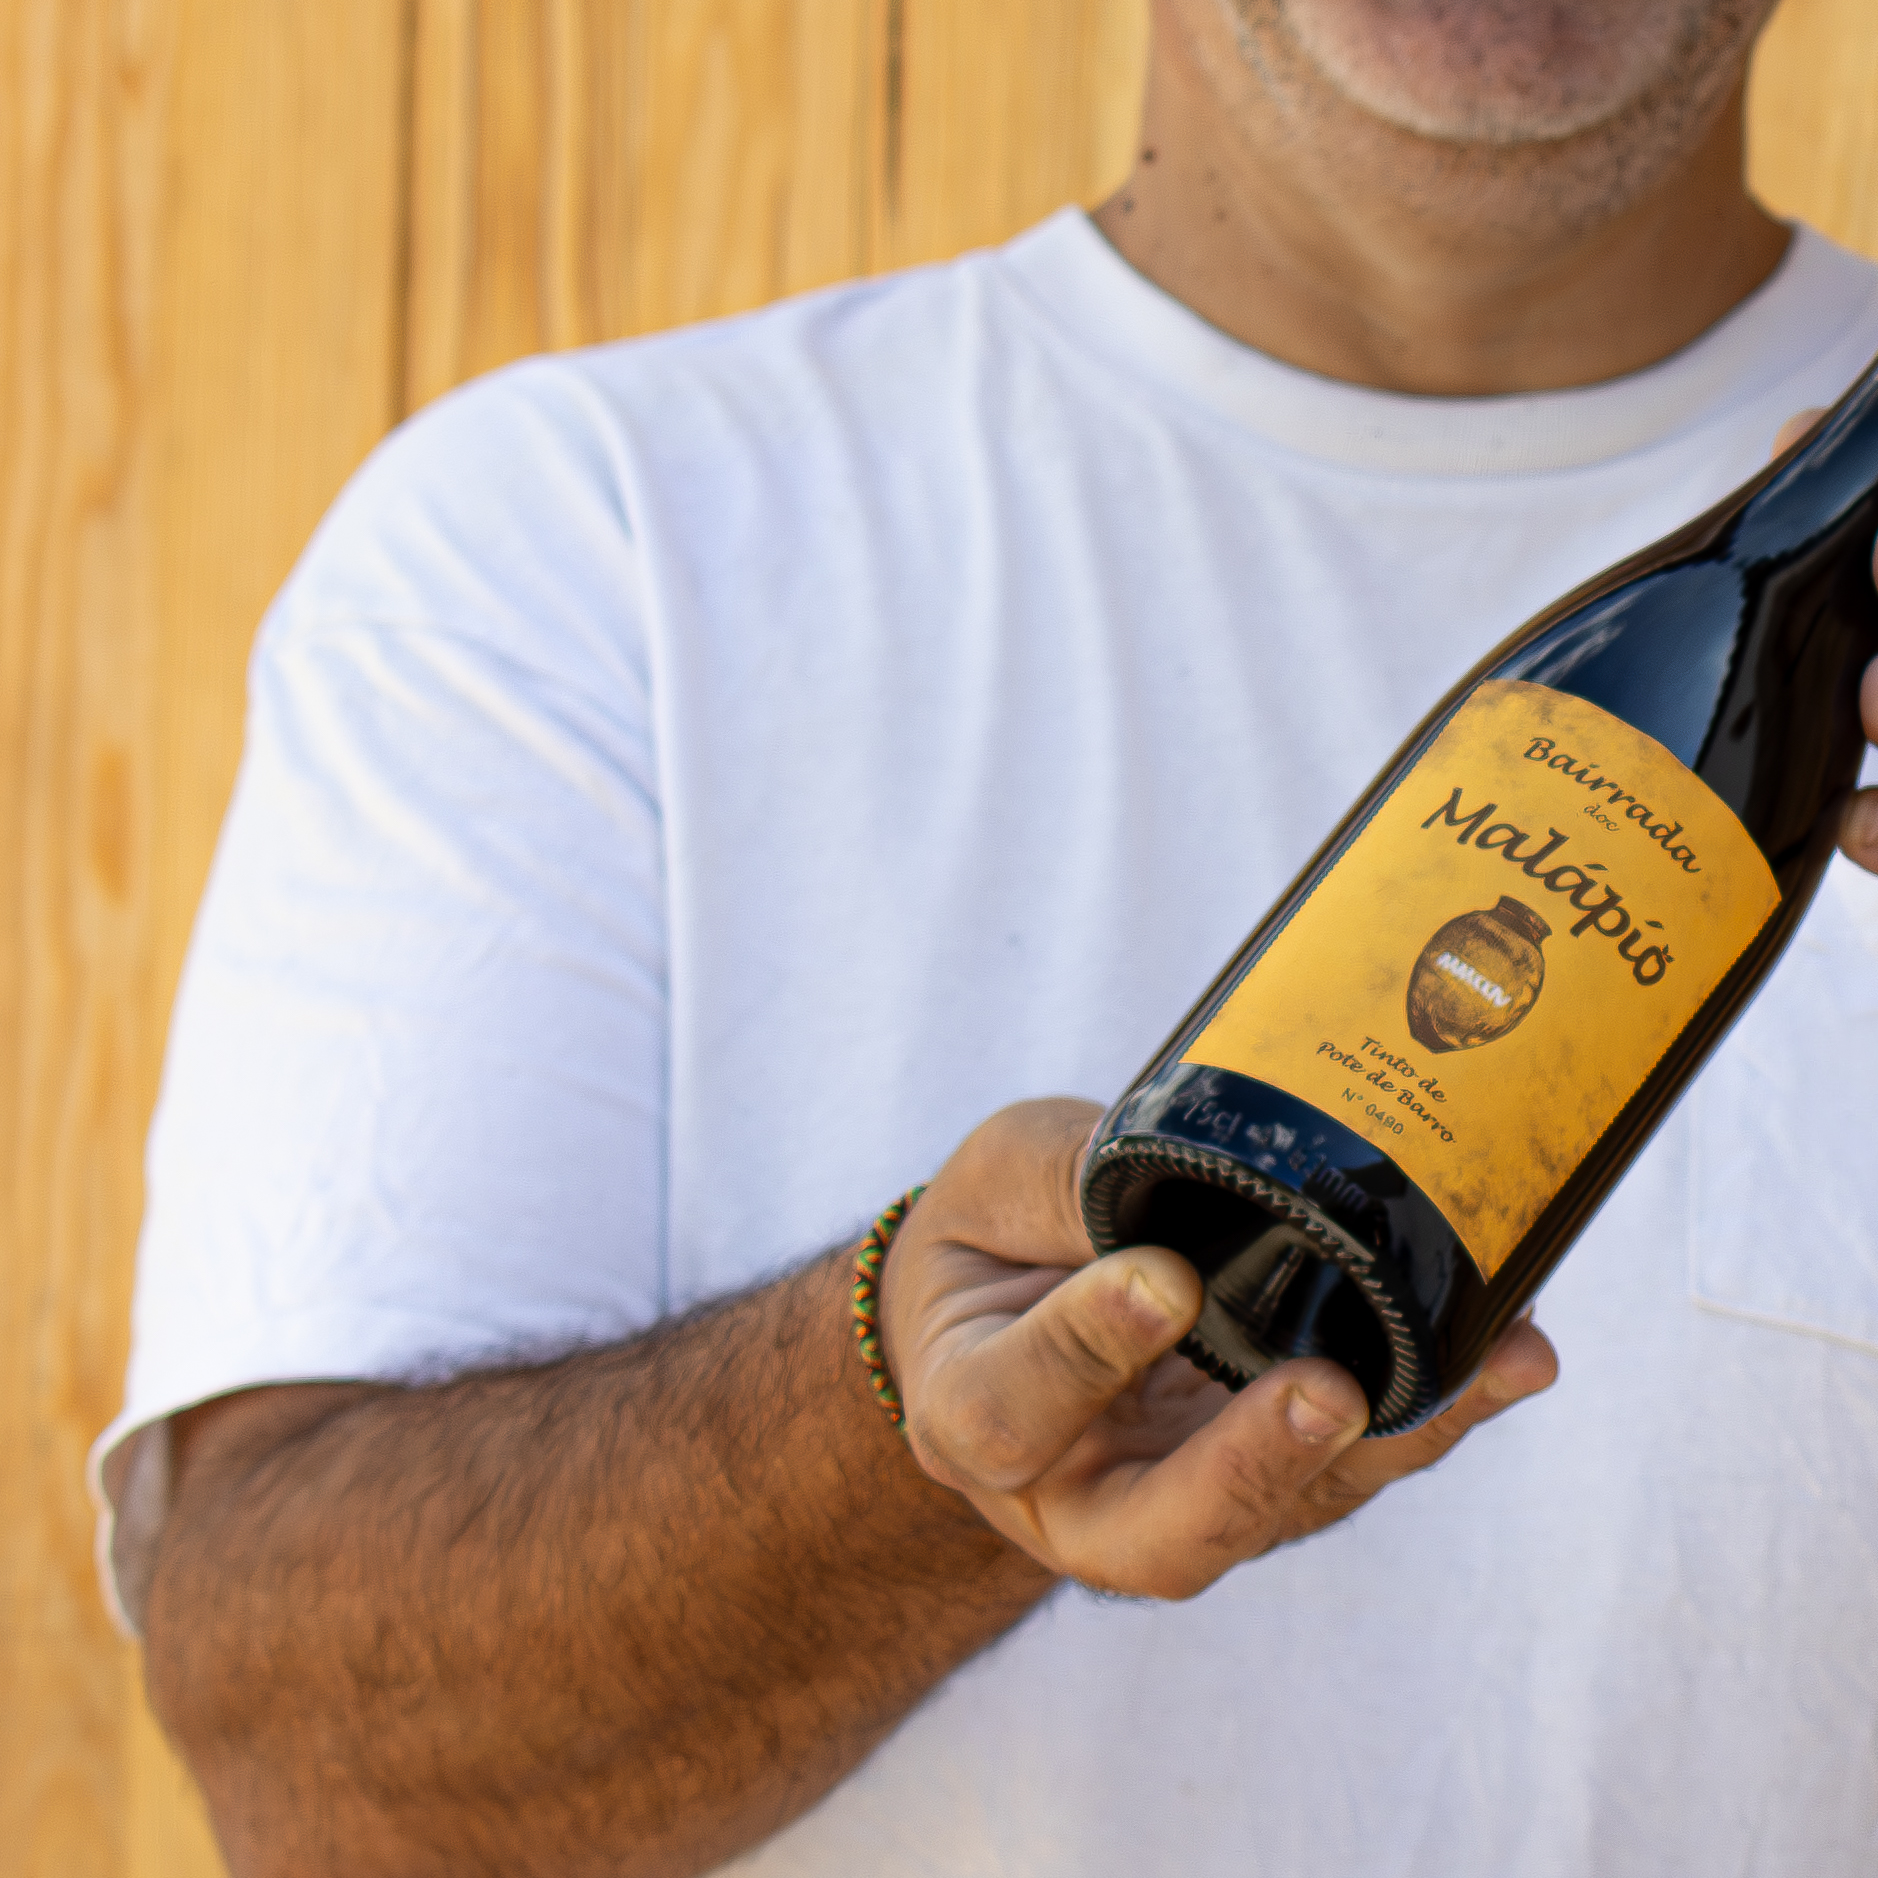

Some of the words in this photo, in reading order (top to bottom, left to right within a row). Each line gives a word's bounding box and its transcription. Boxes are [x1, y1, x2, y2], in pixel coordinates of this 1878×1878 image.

[1523, 737, 1702, 873] Bairrada
[1316, 1041, 1366, 1073] Pote
[1366, 1069, 1398, 1092] de
[1397, 1088, 1457, 1143] Barro
[1360, 1036, 1419, 1078] Tinto
[1418, 1077, 1447, 1103] de
